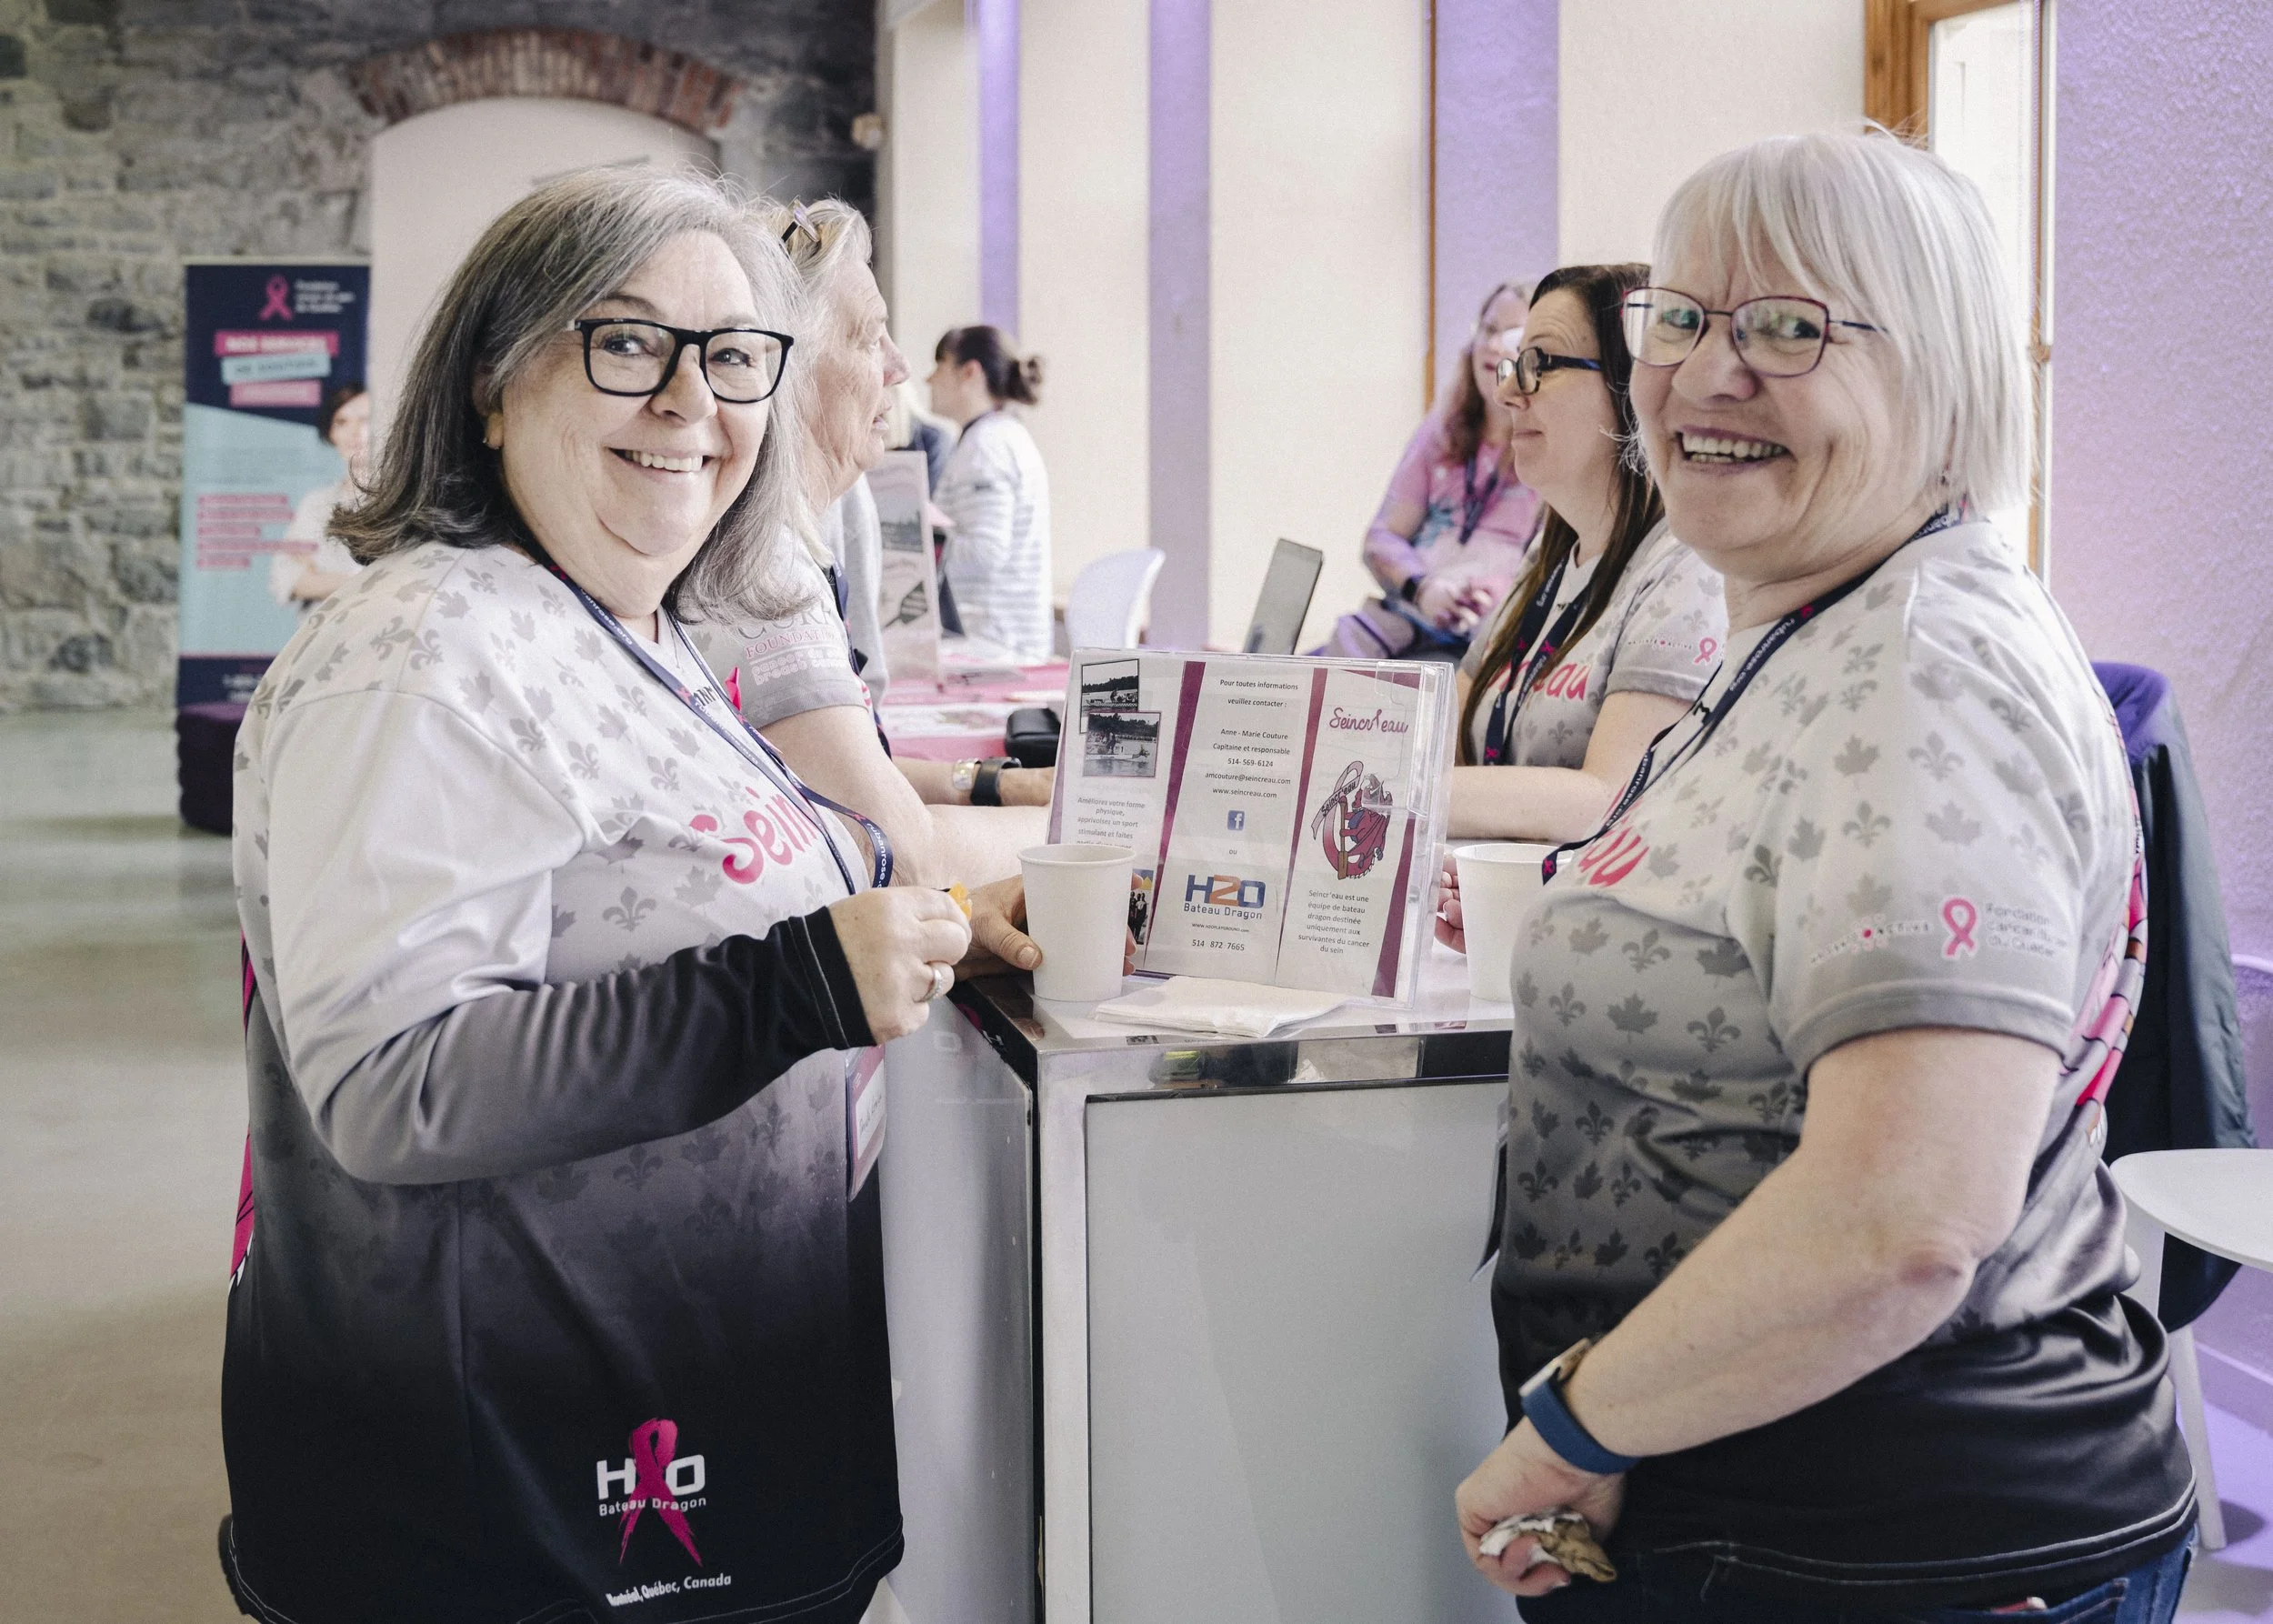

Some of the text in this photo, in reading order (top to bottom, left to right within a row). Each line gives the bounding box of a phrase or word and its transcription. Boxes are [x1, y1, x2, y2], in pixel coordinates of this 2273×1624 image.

[1236, 680, 1257, 688] toutes
[1257, 681, 1298, 690] informations
[1227, 697, 1251, 706] veuillez
[1220, 728, 1237, 737] Anne
[1242, 730, 1261, 738] Marie
[1262, 731, 1288, 740] Couture
[1212, 743, 1242, 752] Capitaine
[1251, 746, 1291, 756] responsable
[1205, 771, 1291, 785] amcouture@seincreau.com
[1212, 787, 1277, 798] www.seincreau.com
[1126, 800, 1146, 809] forme
[1095, 807, 1125, 817] physique,
[1076, 817, 1111, 826] apprivoisez
[1121, 820, 1138, 828] sport
[1077, 828, 1106, 837] stimulant
[1115, 831, 1134, 839] faites
[1185, 874, 1267, 909] H2O
[1308, 889, 1344, 900] Seincr'eau
[1183, 902, 1263, 920] Bateau Dragon
[1307, 901, 1331, 911] équipe
[1341, 905, 1366, 914] bateau
[1307, 912, 1362, 925] dragon destinée
[1306, 924, 1347, 934] uniquement
[1192, 938, 1246, 952] 514 872 7665
[1298, 933, 1336, 944] survivantes
[1347, 939, 1370, 947] cancer
[1319, 945, 1328, 953] du
[598, 1497, 706, 1517] Bateau Dragon
[641, 1580, 680, 1599] Québec,
[683, 1572, 732, 1589] Canada
